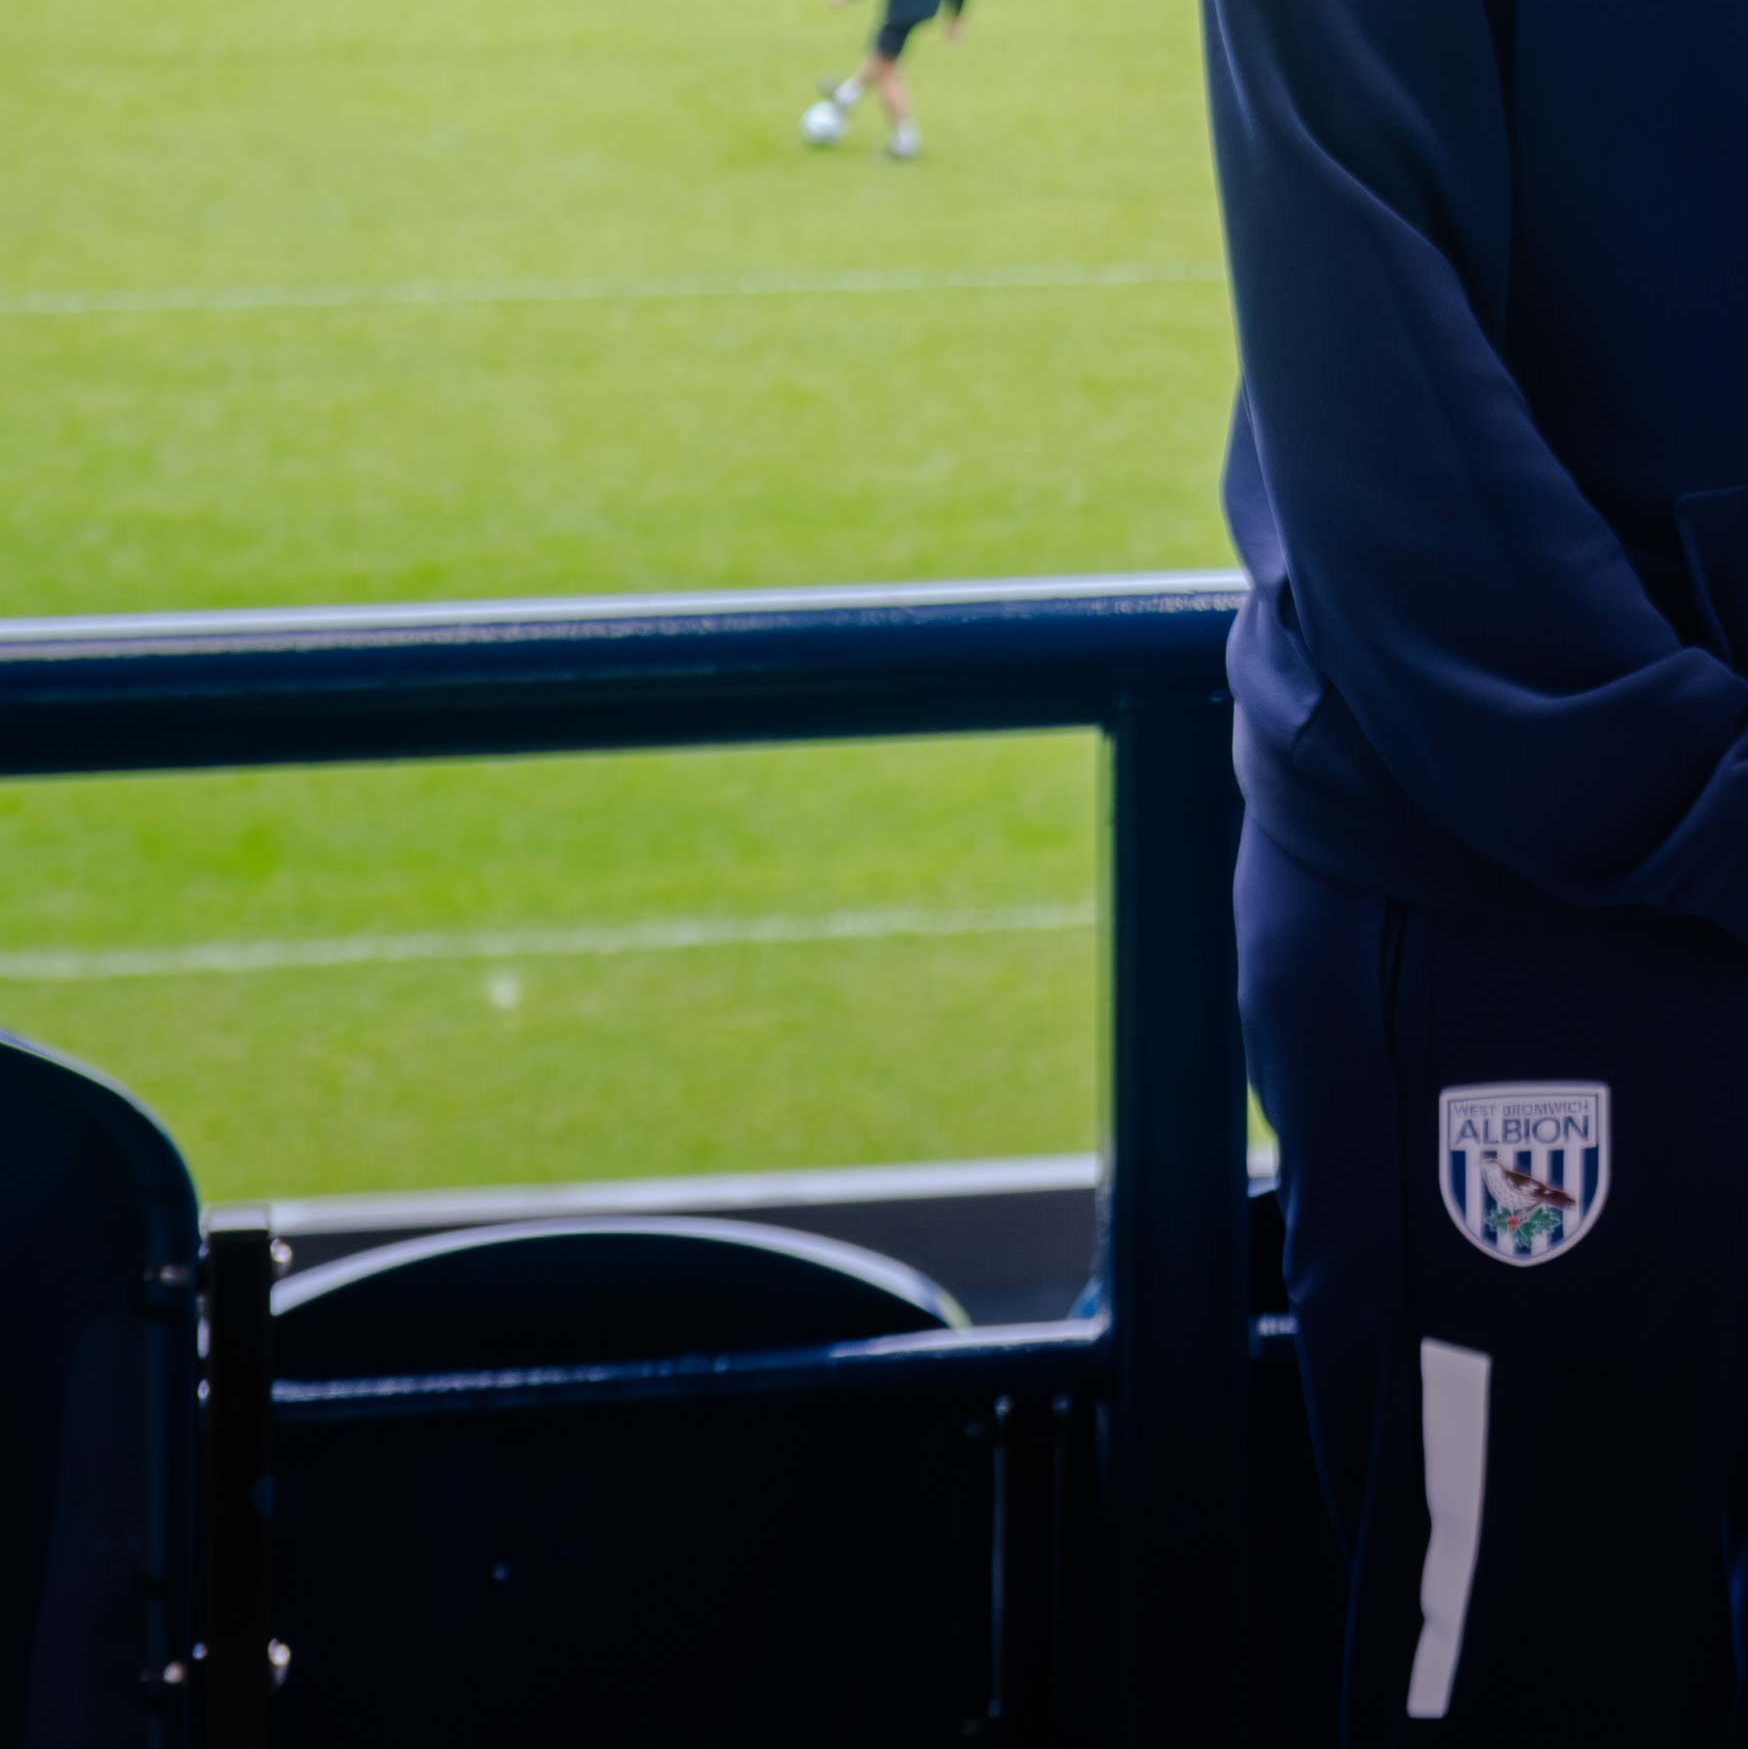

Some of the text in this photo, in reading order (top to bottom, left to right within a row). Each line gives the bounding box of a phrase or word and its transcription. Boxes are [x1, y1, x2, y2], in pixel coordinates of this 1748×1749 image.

[1454, 1101, 1589, 1117] WEST BROMWICH
[1454, 1116, 1589, 1145] ALBION
